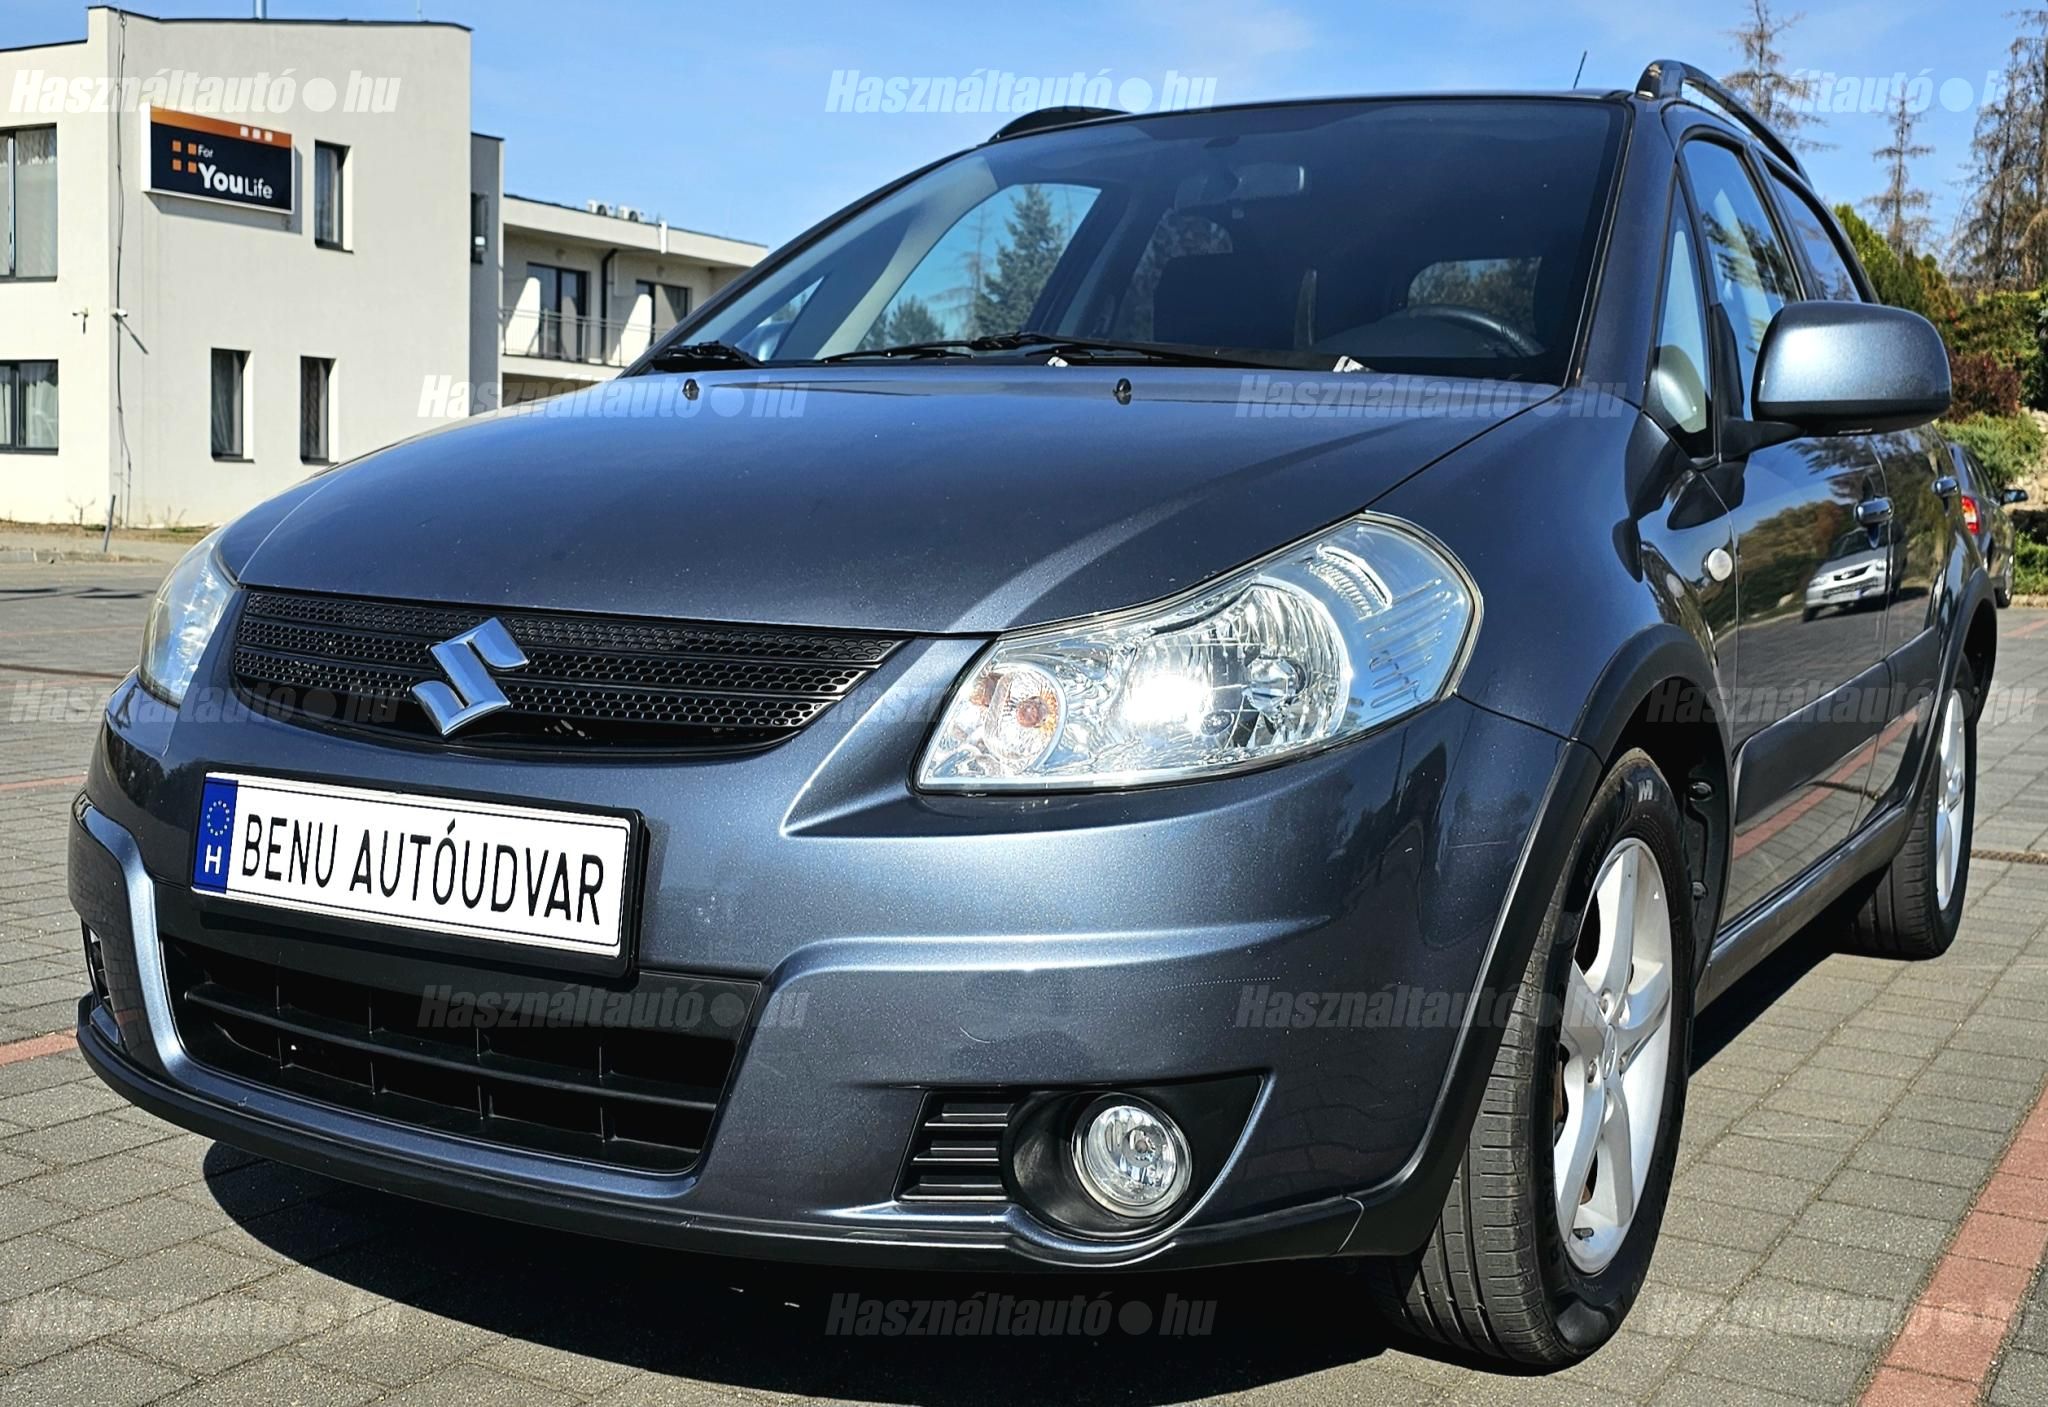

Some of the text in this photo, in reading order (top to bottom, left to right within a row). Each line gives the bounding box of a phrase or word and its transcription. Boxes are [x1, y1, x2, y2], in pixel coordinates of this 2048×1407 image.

[198, 143, 214, 158] For
[203, 844, 223, 875] H
[242, 813, 605, 926] BENU AUTÓUDVAR
